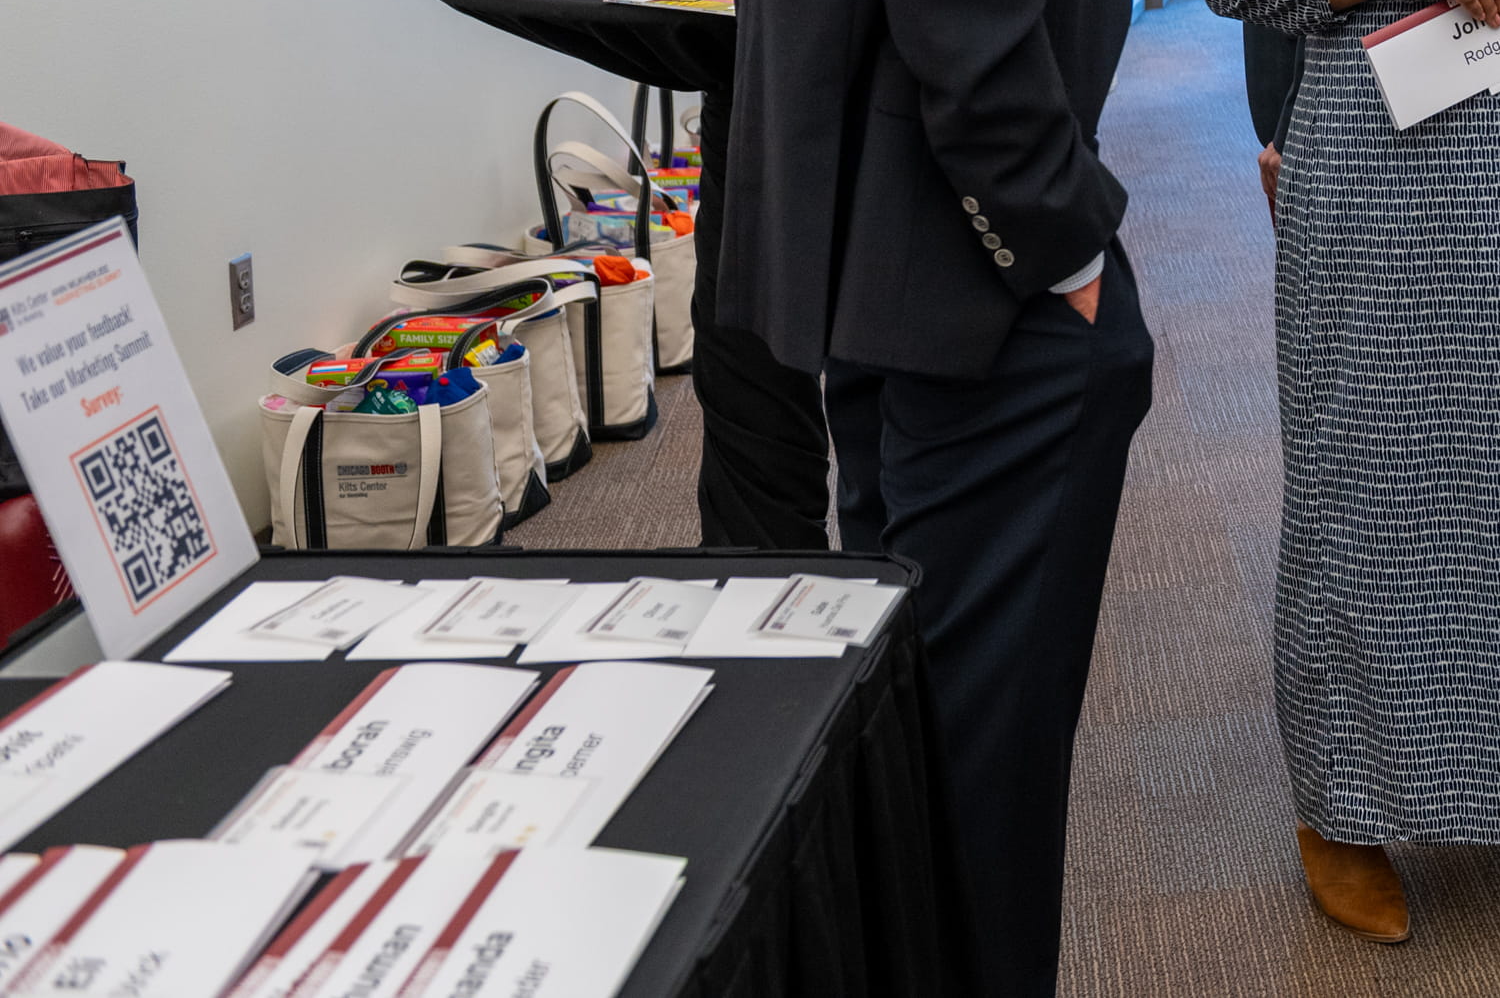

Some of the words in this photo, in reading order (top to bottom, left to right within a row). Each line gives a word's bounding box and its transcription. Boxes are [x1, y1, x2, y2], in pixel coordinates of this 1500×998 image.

[400, 334, 435, 345] FAMILY
[16, 354, 38, 376] We
[36, 342, 66, 367] value
[65, 331, 89, 357] your
[20, 387, 50, 413] Take
[49, 377, 67, 399] our
[65, 352, 119, 389] Marketing
[113, 330, 154, 363] Summit
[371, 464, 395, 475] BOOTH
[338, 482, 357, 491] Kilts
[360, 481, 388, 492] Center
